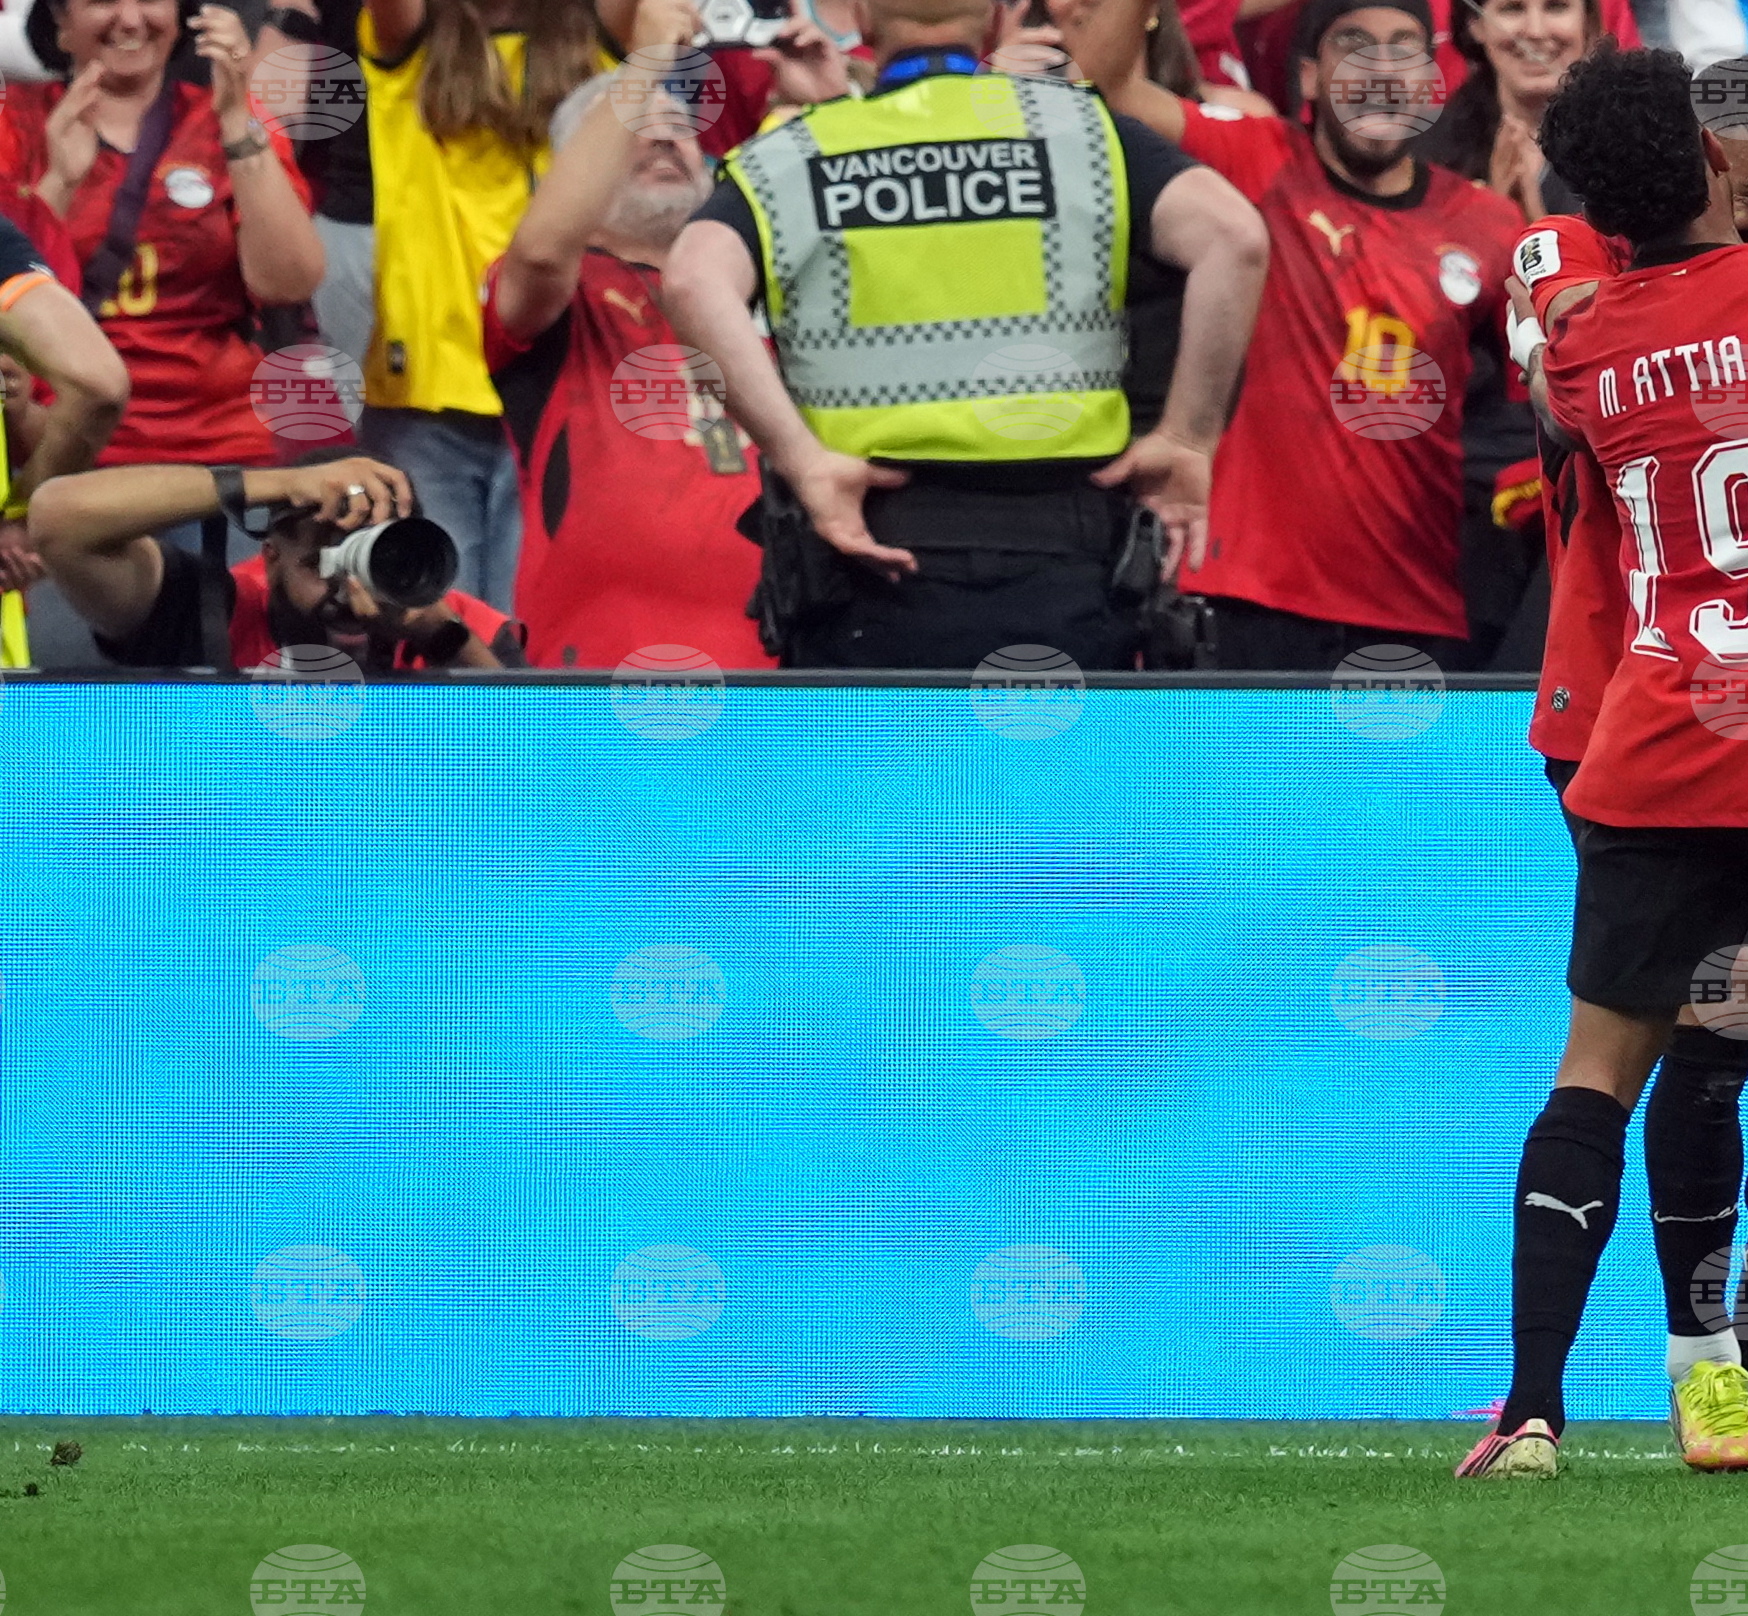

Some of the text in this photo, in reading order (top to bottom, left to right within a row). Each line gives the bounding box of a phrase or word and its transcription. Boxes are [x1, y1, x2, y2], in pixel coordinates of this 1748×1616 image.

[820, 142, 1038, 183] VANCOUVER
[823, 169, 1048, 227] POLICE
[1599, 335, 1747, 418] M. ATTIA
